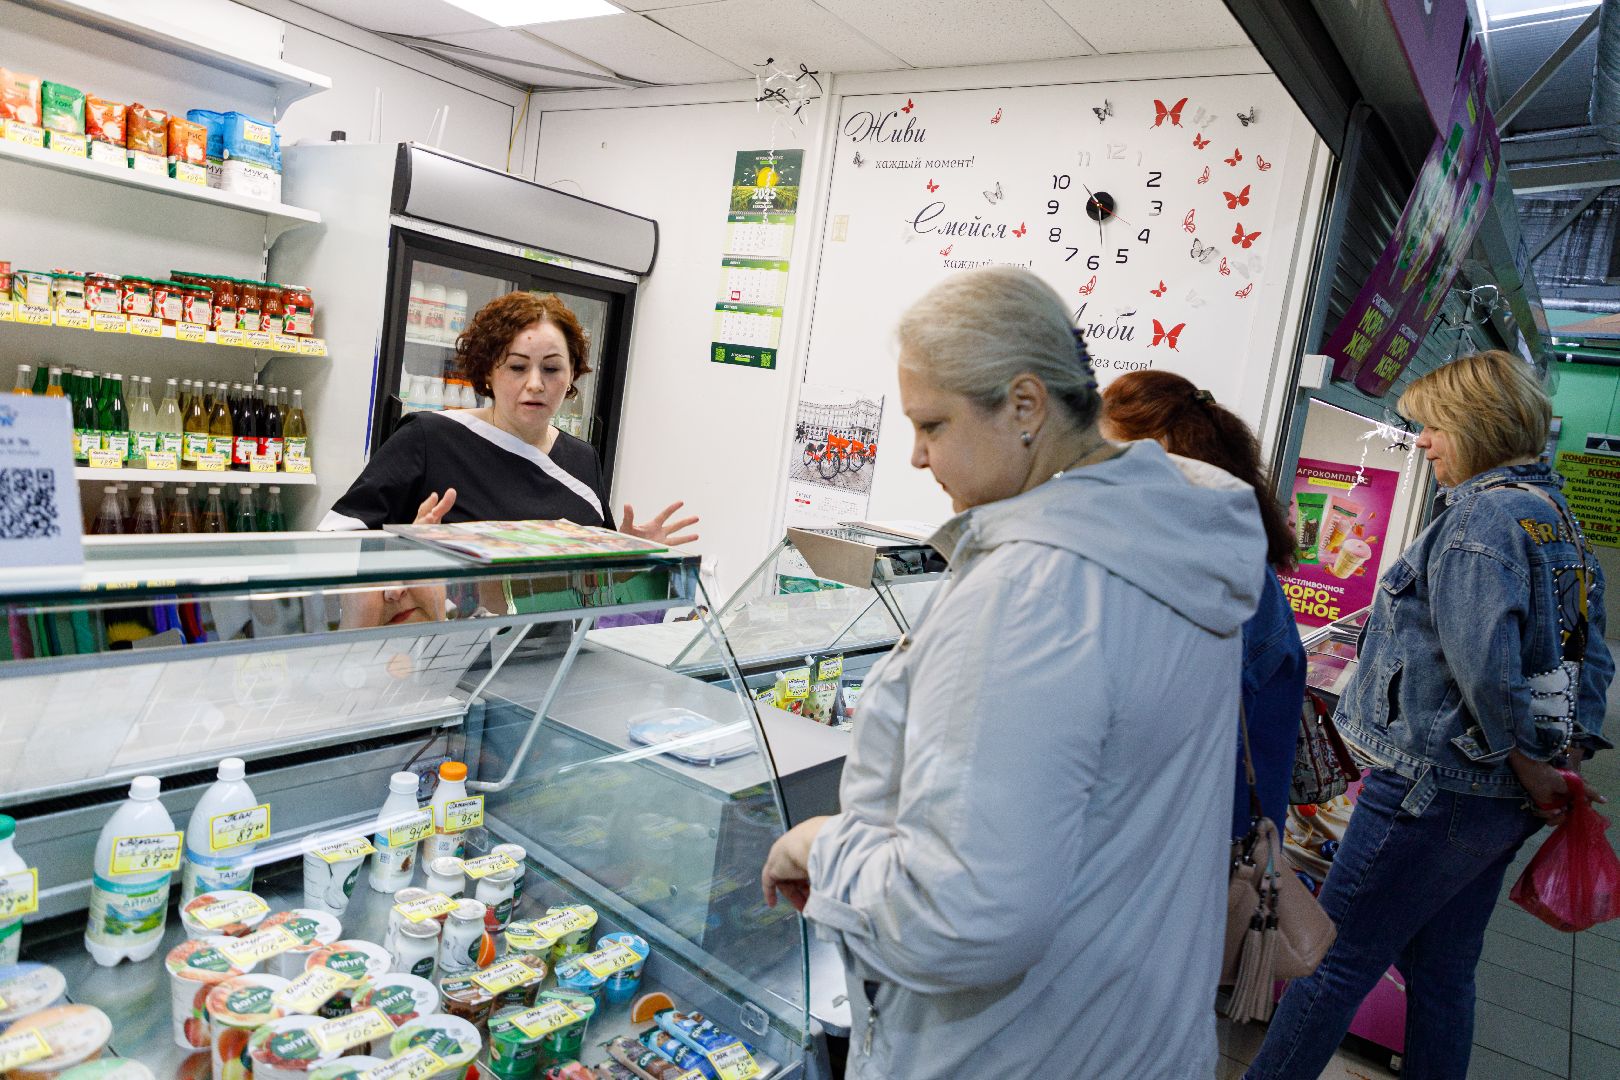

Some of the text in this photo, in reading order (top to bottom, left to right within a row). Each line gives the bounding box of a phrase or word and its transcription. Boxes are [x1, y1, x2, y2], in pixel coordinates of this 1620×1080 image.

[844, 110, 926, 144] Живи
[187, 131, 203, 140] РИС
[875, 155, 975, 169] каждый момент!
[244, 167, 270, 180] МУКА
[1147, 172, 1161, 187] 2
[1053, 175, 1070, 189] 10
[752, 187, 777, 199] 2025
[1047, 200, 1059, 214] 9
[1149, 200, 1162, 216] 3
[904, 201, 1007, 239] Смейся
[1049, 227, 1061, 242] 8
[1138, 228, 1150, 244] 4
[1065, 247, 1078, 261] 7
[1116, 248, 1128, 263] 5
[1087, 255, 1099, 270] 6
[1297, 467, 1369, 485] АГРОКОМПЛЕС
[1566, 477, 1594, 485] АСНЫЙ
[1576, 512, 1611, 521] ЛАВЯНКА
[1287, 597, 1341, 621] ЕНОЕ
[219, 871, 238, 879] ТАН
